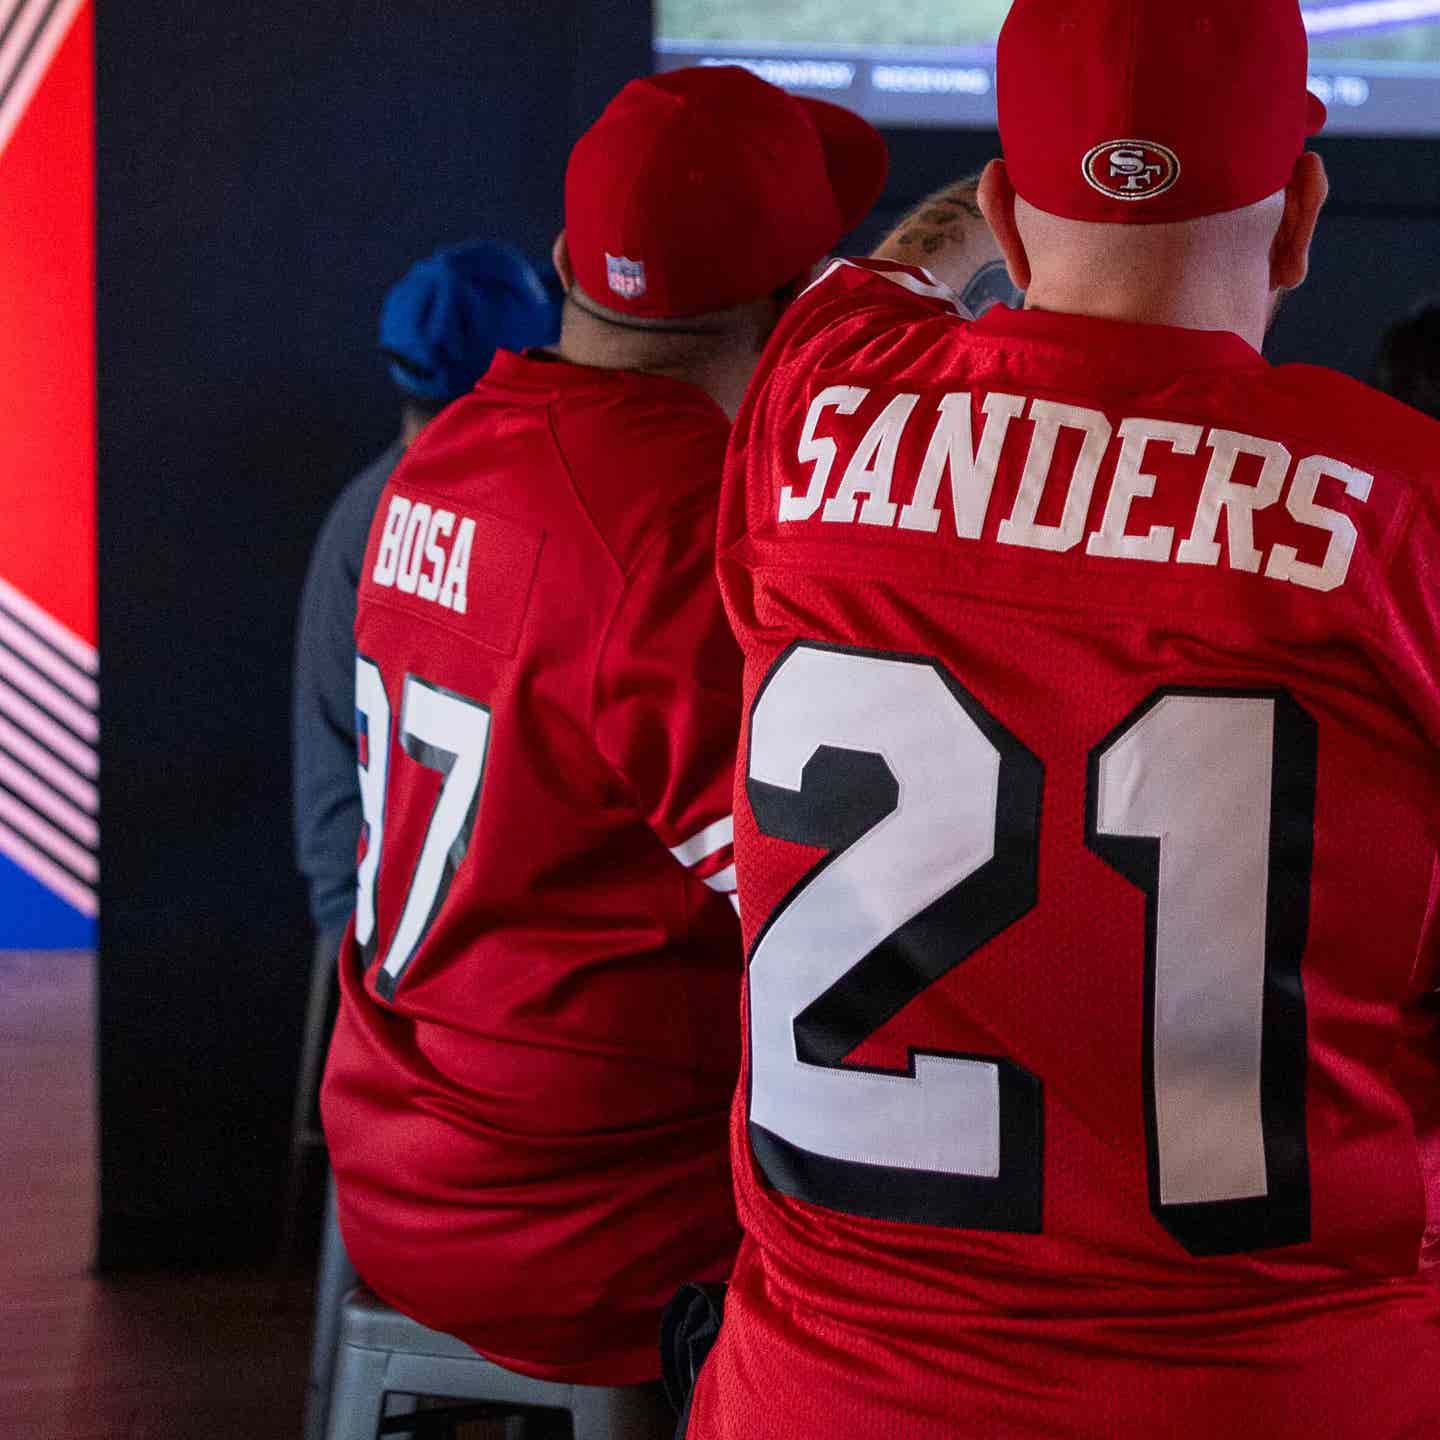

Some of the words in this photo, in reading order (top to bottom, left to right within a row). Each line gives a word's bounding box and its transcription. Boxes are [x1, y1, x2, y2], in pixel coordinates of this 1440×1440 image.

[1109, 148, 1161, 190] SF
[372, 495, 476, 614] BOSA
[778, 385, 1375, 593] SANDERS
[746, 639, 1318, 1257] 21
